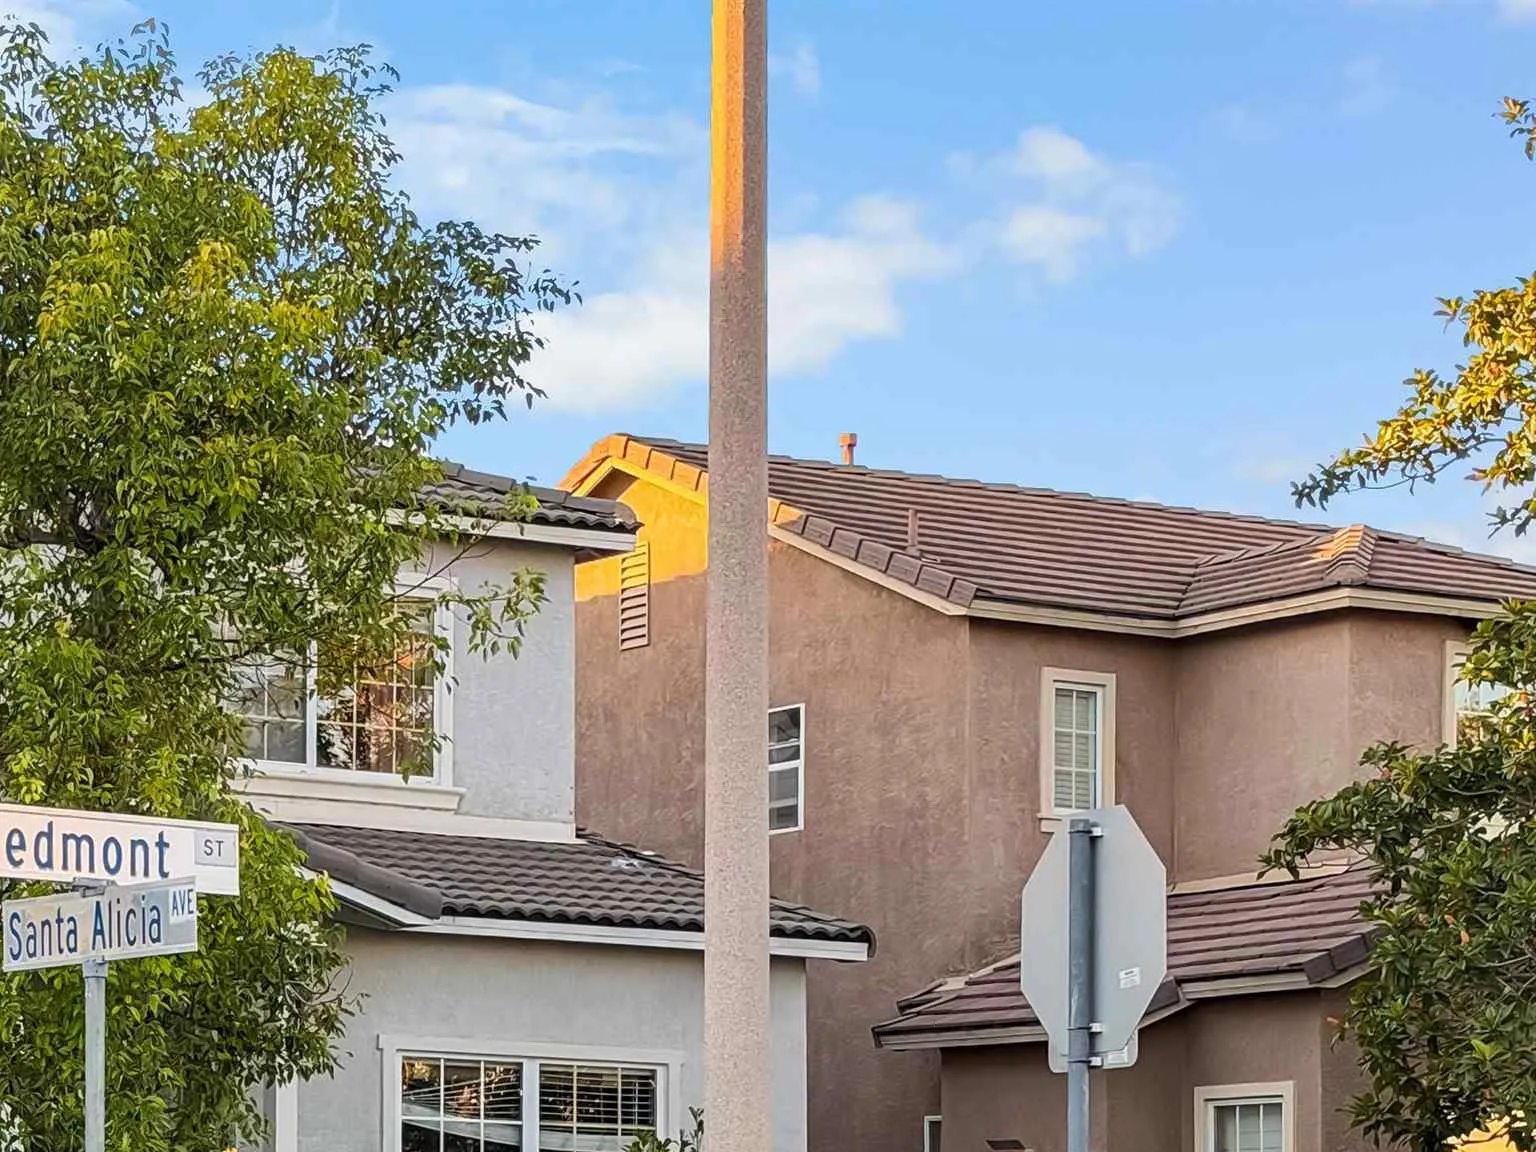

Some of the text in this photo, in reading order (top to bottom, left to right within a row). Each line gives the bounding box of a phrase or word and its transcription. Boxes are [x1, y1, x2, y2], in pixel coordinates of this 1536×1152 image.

[203, 839, 225, 857] ST
[9, 888, 195, 961] Santa Alicia AVE
